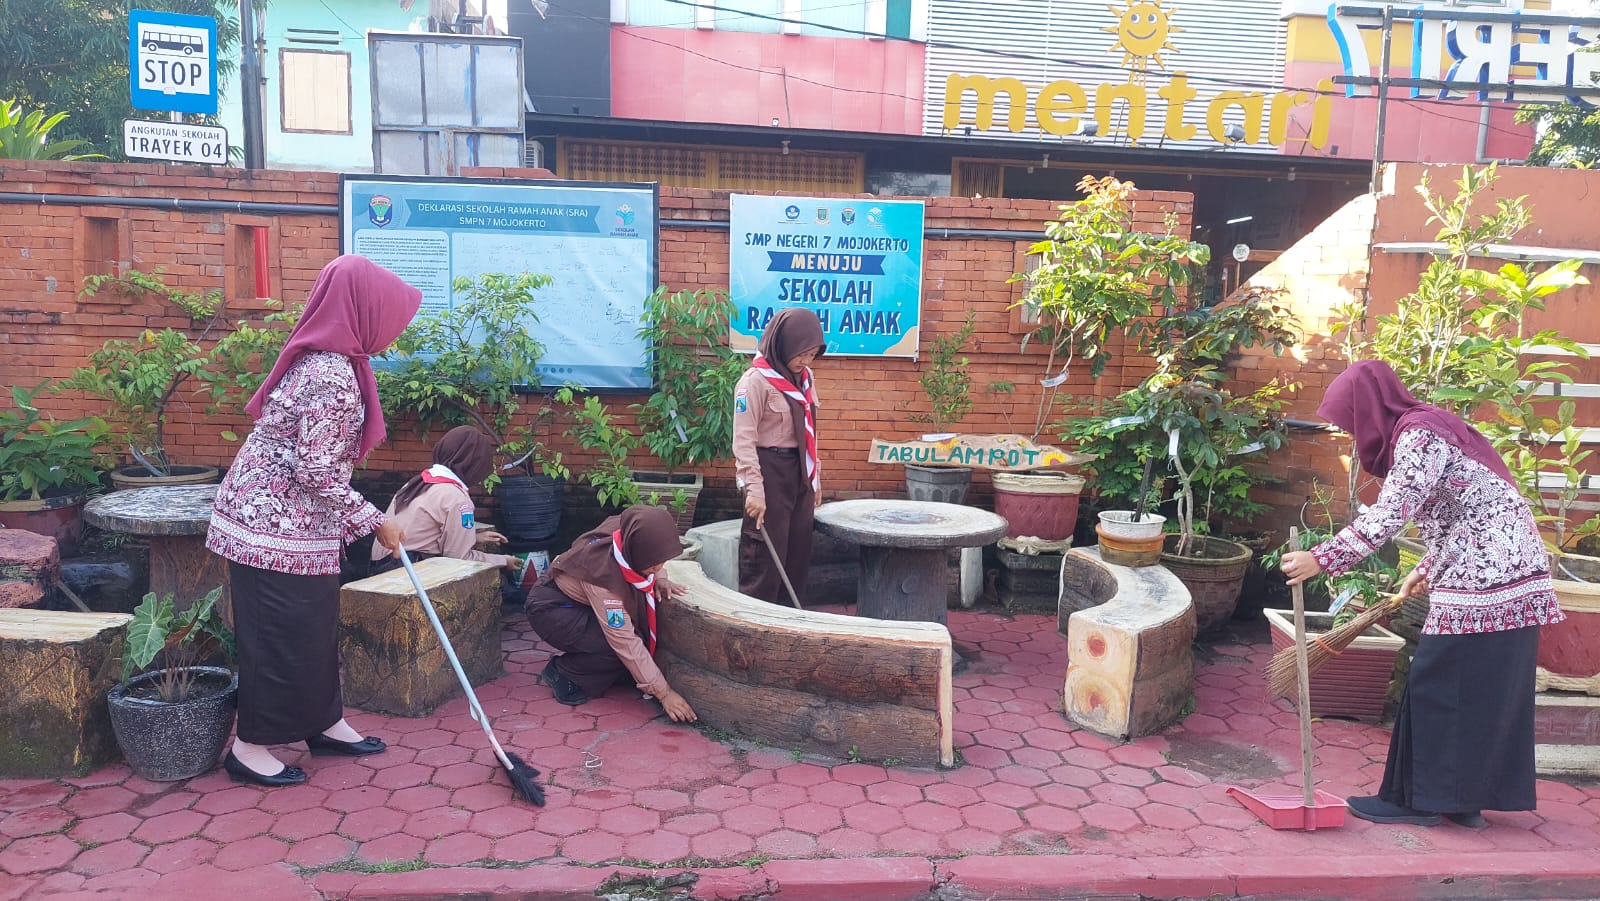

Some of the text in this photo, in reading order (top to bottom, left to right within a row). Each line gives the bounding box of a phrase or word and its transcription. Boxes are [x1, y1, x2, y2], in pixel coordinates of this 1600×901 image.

[145, 59, 202, 86] STOP
[941, 69, 1335, 151] mentari
[131, 125, 220, 141] ANGKUTAN SEKOLAH
[130, 137, 223, 159] TRAYEK 04
[418, 202, 589, 218] DEKLARASI SEKOLAH RAMAH ANAK (SRA)
[459, 216, 547, 229] SMPN 7 MOJOKERTO
[744, 232, 909, 252] SMP NEGERI 7 MOJOKERTO
[790, 254, 863, 271] MENUJU
[777, 277, 873, 305] SEKOLAH
[747, 306, 902, 335] RAH ANAK
[876, 444, 1040, 467] TABULAMPOT
